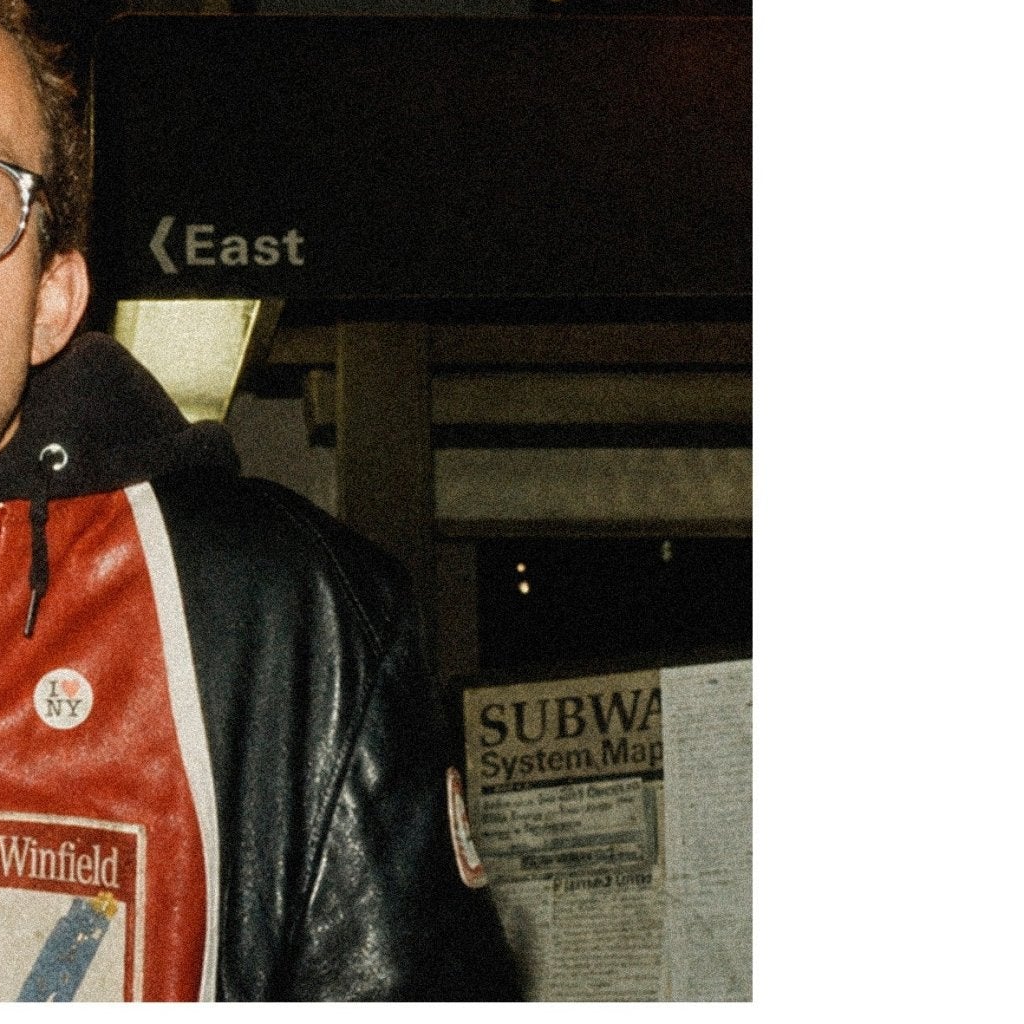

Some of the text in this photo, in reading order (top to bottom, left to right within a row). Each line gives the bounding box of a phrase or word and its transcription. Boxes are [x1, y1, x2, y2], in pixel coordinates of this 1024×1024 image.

[185, 224, 305, 266] East
[49, 680, 59, 697] I
[46, 699, 83, 717] NY
[480, 737, 663, 780] System Map
